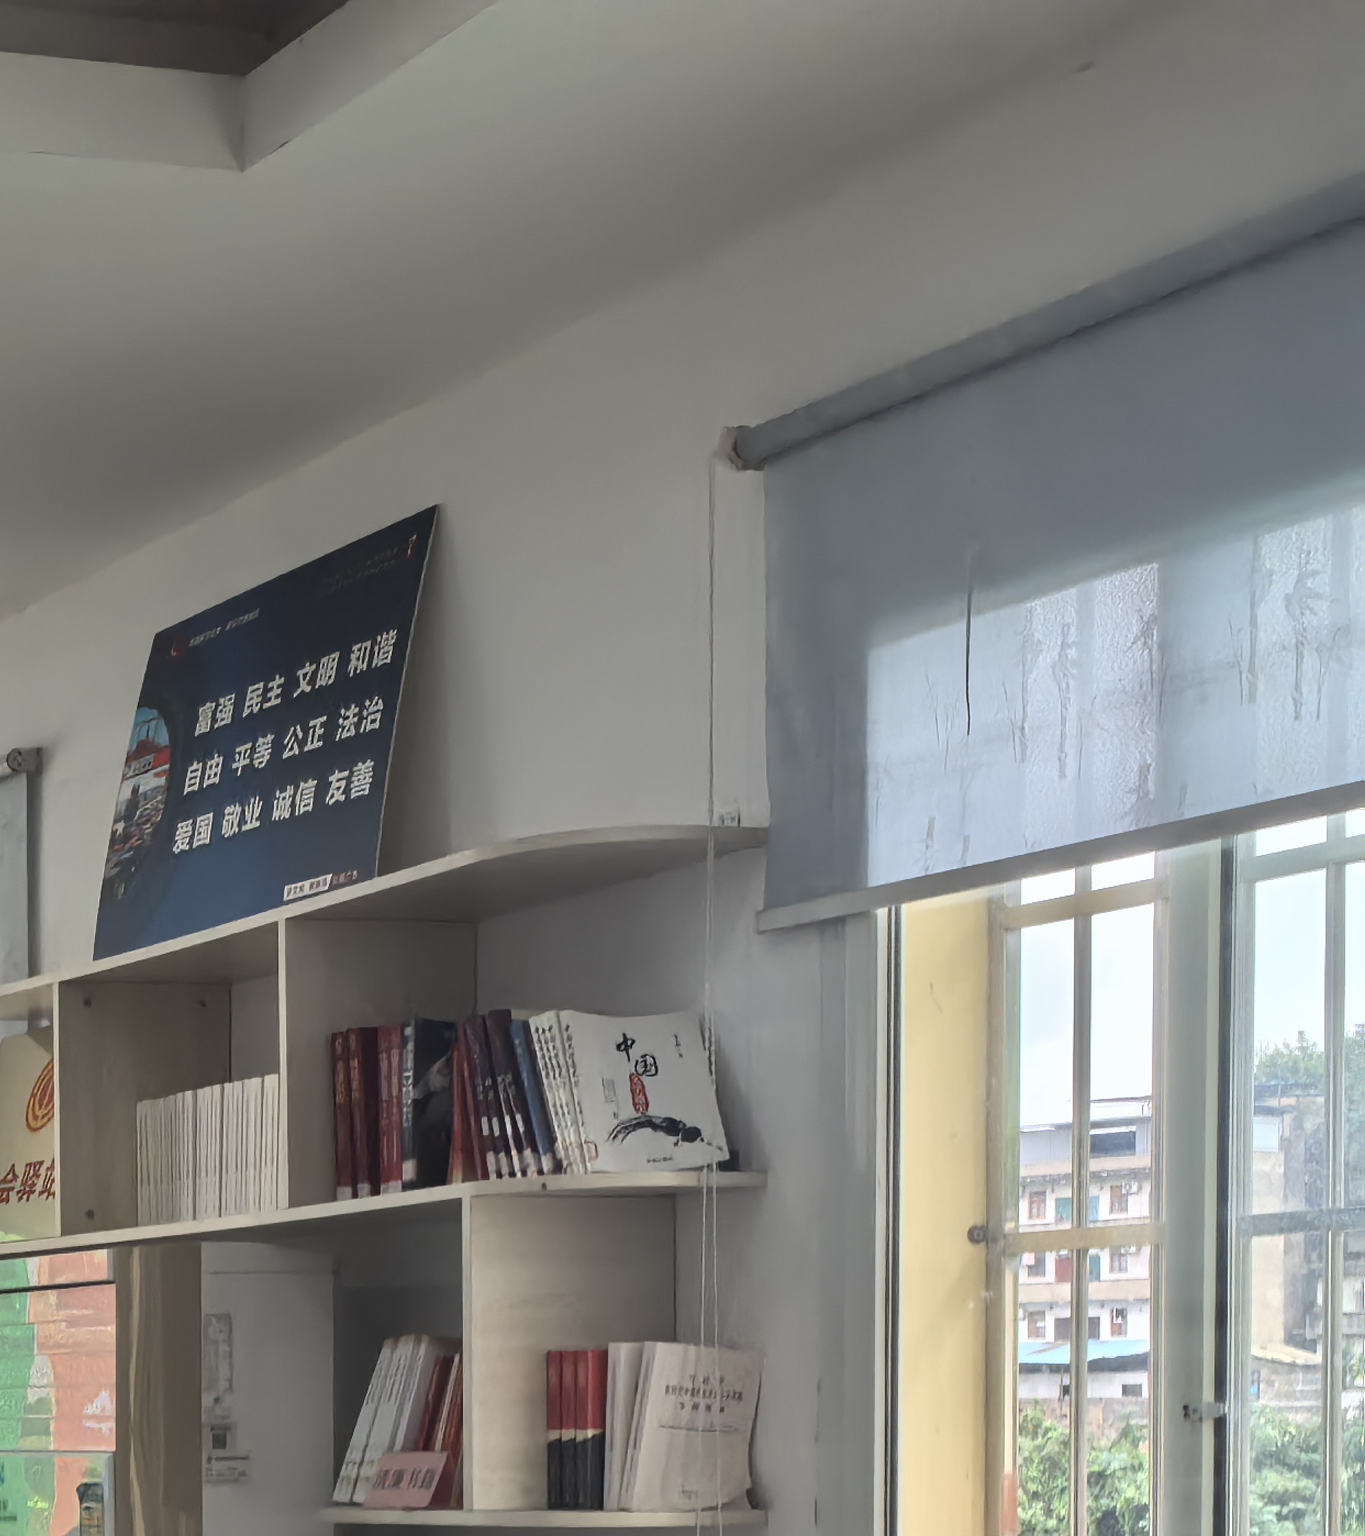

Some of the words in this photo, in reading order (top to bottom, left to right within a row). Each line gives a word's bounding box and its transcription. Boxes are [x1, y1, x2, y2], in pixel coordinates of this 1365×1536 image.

[194, 693, 236, 737] 富强
[242, 674, 285, 719] 民主
[293, 651, 340, 699] 文明
[347, 628, 398, 678] 和谐
[183, 753, 223, 796] 自由
[231, 733, 275, 777] 平等
[282, 715, 328, 760] 公正
[335, 695, 384, 742] 法治
[172, 812, 214, 855] 爱国
[221, 796, 263, 839] 敬业
[271, 778, 318, 822] 诚信
[325, 759, 375, 806] 友善
